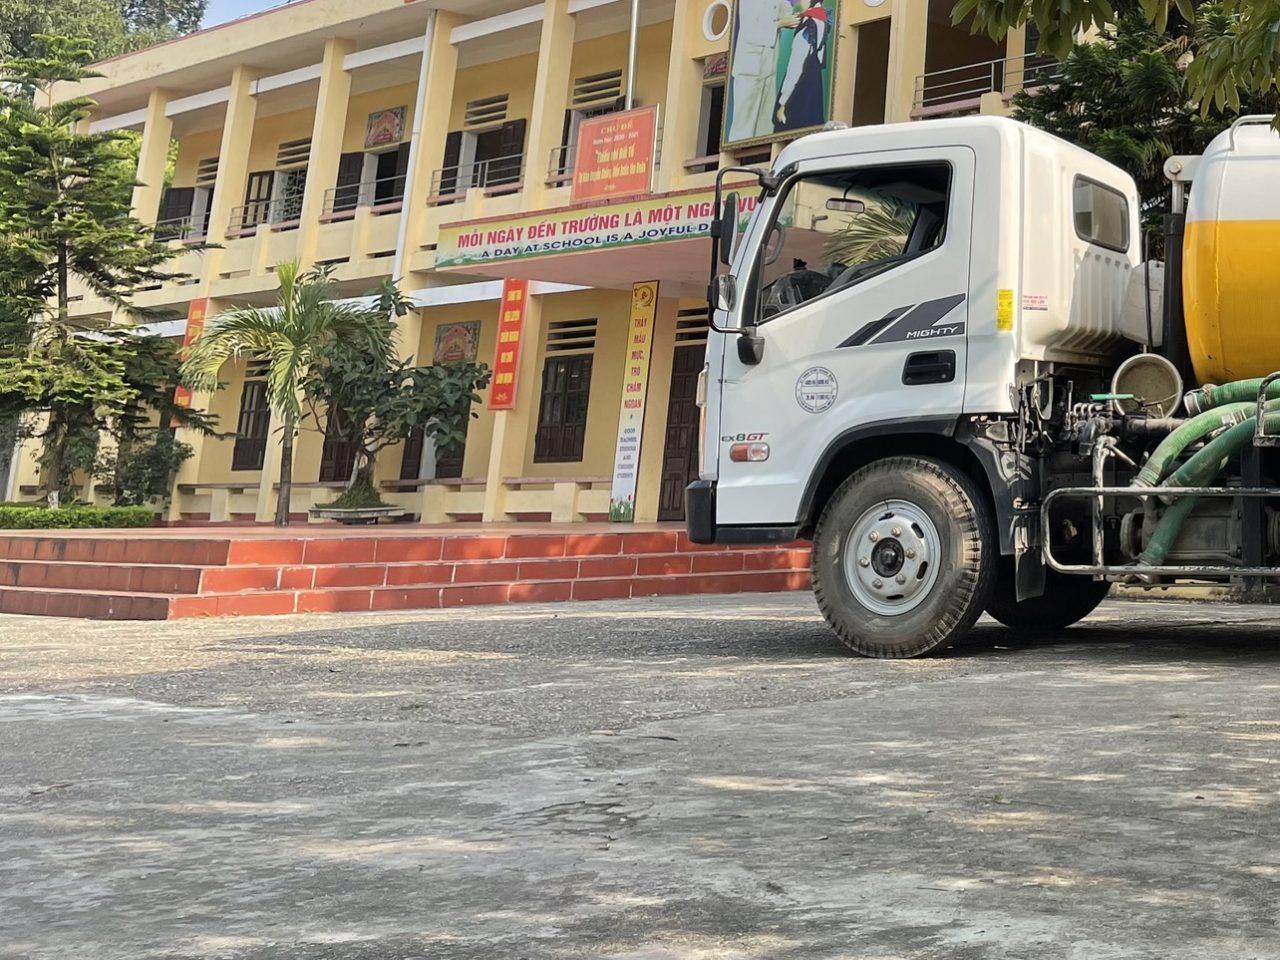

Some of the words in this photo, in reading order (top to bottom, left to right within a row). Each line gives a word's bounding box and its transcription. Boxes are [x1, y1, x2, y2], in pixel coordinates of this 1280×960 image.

[487, 226, 524, 244] NGÀY
[527, 219, 556, 239] ĐẾN
[561, 214, 620, 235] TRƯỜNG
[624, 208, 643, 227] LÀ
[648, 204, 683, 225] MỘT
[481, 250, 490, 258] A
[494, 246, 519, 256] DAY
[524, 243, 539, 252] AT
[543, 236, 602, 249] SCHOOL
[606, 234, 619, 242] IS
[623, 232, 633, 240] A
[638, 225, 694, 238] JOYFUL
[906, 326, 959, 339] MIGHTY
[624, 399, 642, 409] NGOAN
